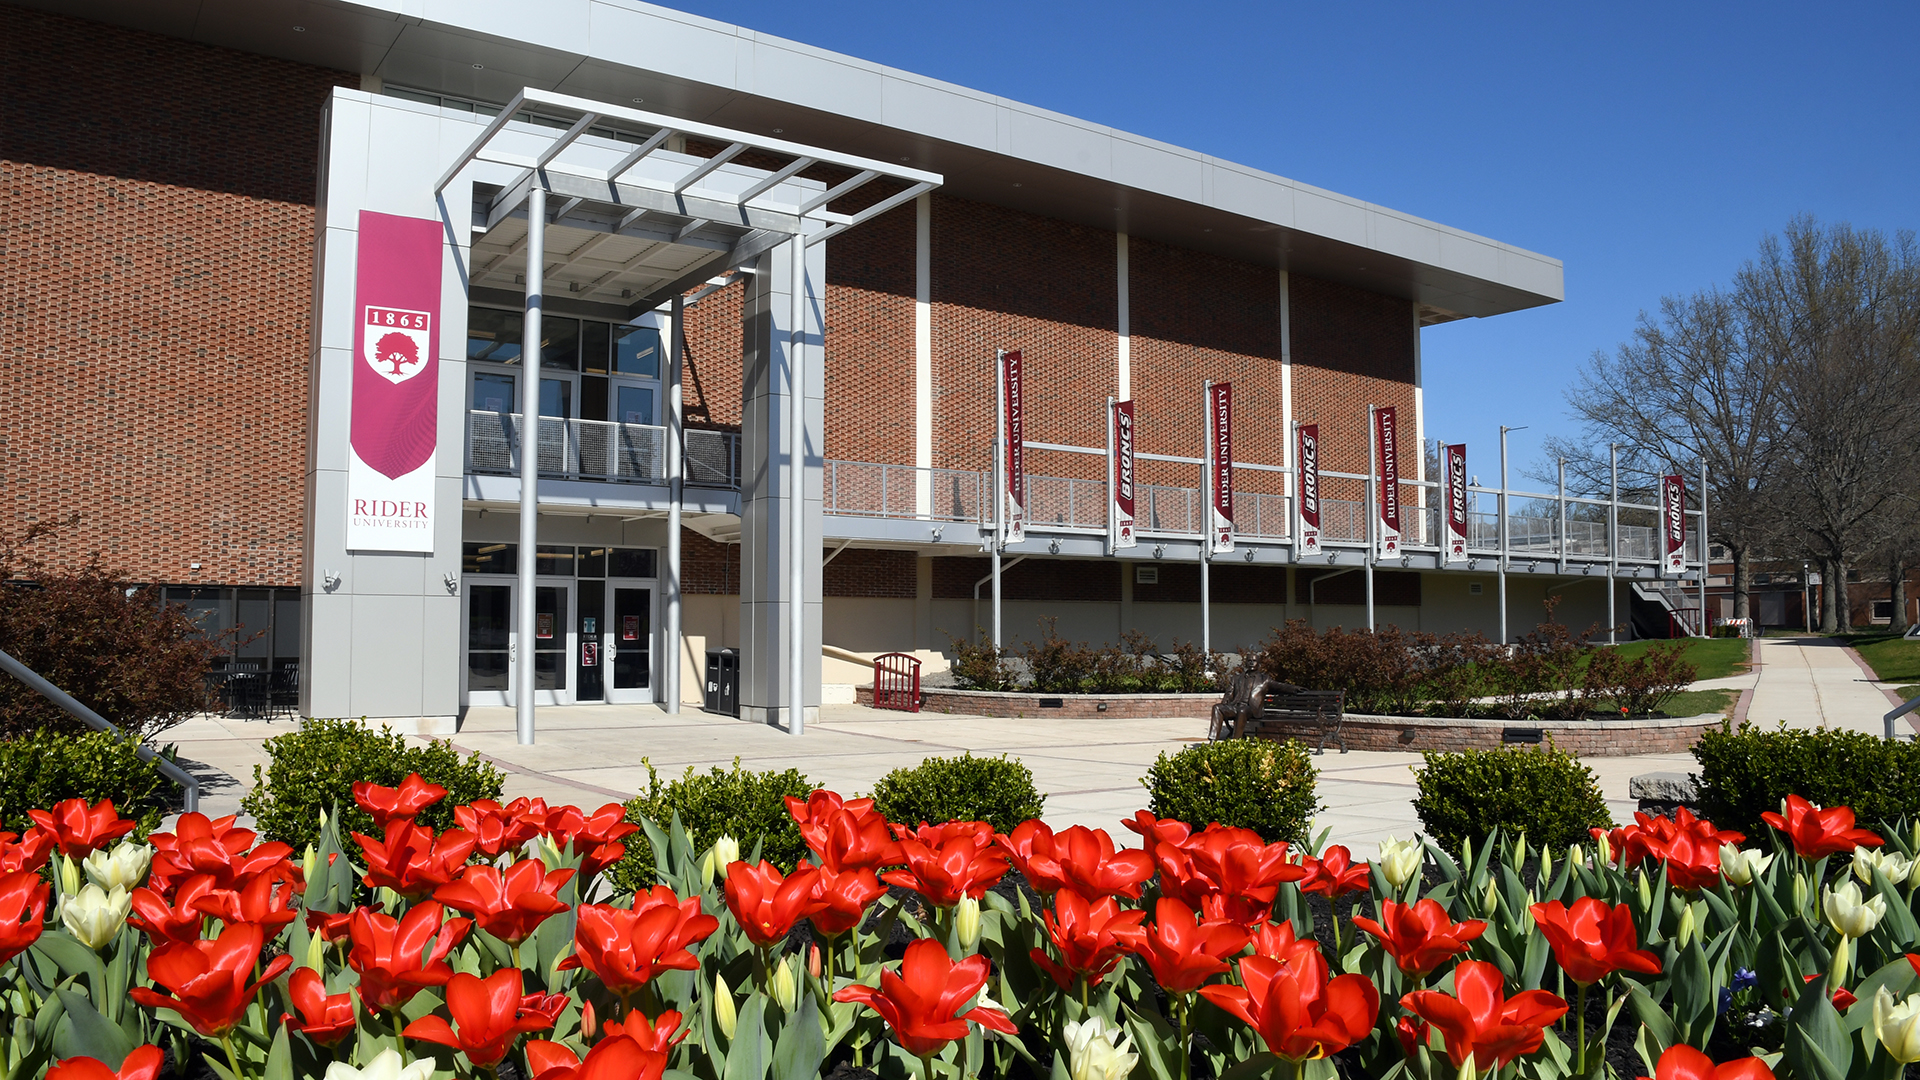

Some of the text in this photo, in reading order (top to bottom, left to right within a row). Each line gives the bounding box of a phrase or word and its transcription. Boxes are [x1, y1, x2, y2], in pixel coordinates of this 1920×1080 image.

[372, 311, 424, 329] 1865
[1010, 358, 1020, 444] UNIVERSITY
[1120, 413, 1132, 500] BRONCS
[1218, 389, 1229, 508] RIDER UNIVERSITY
[1304, 436, 1316, 512] BRONCS
[1382, 412, 1396, 519] RIDER UNIVERSITY
[353, 498, 429, 518] RIDER
[353, 518, 429, 529] UNIVERSITY
[1453, 454, 1464, 523] BRONCS
[1669, 483, 1682, 541] BRONCS
